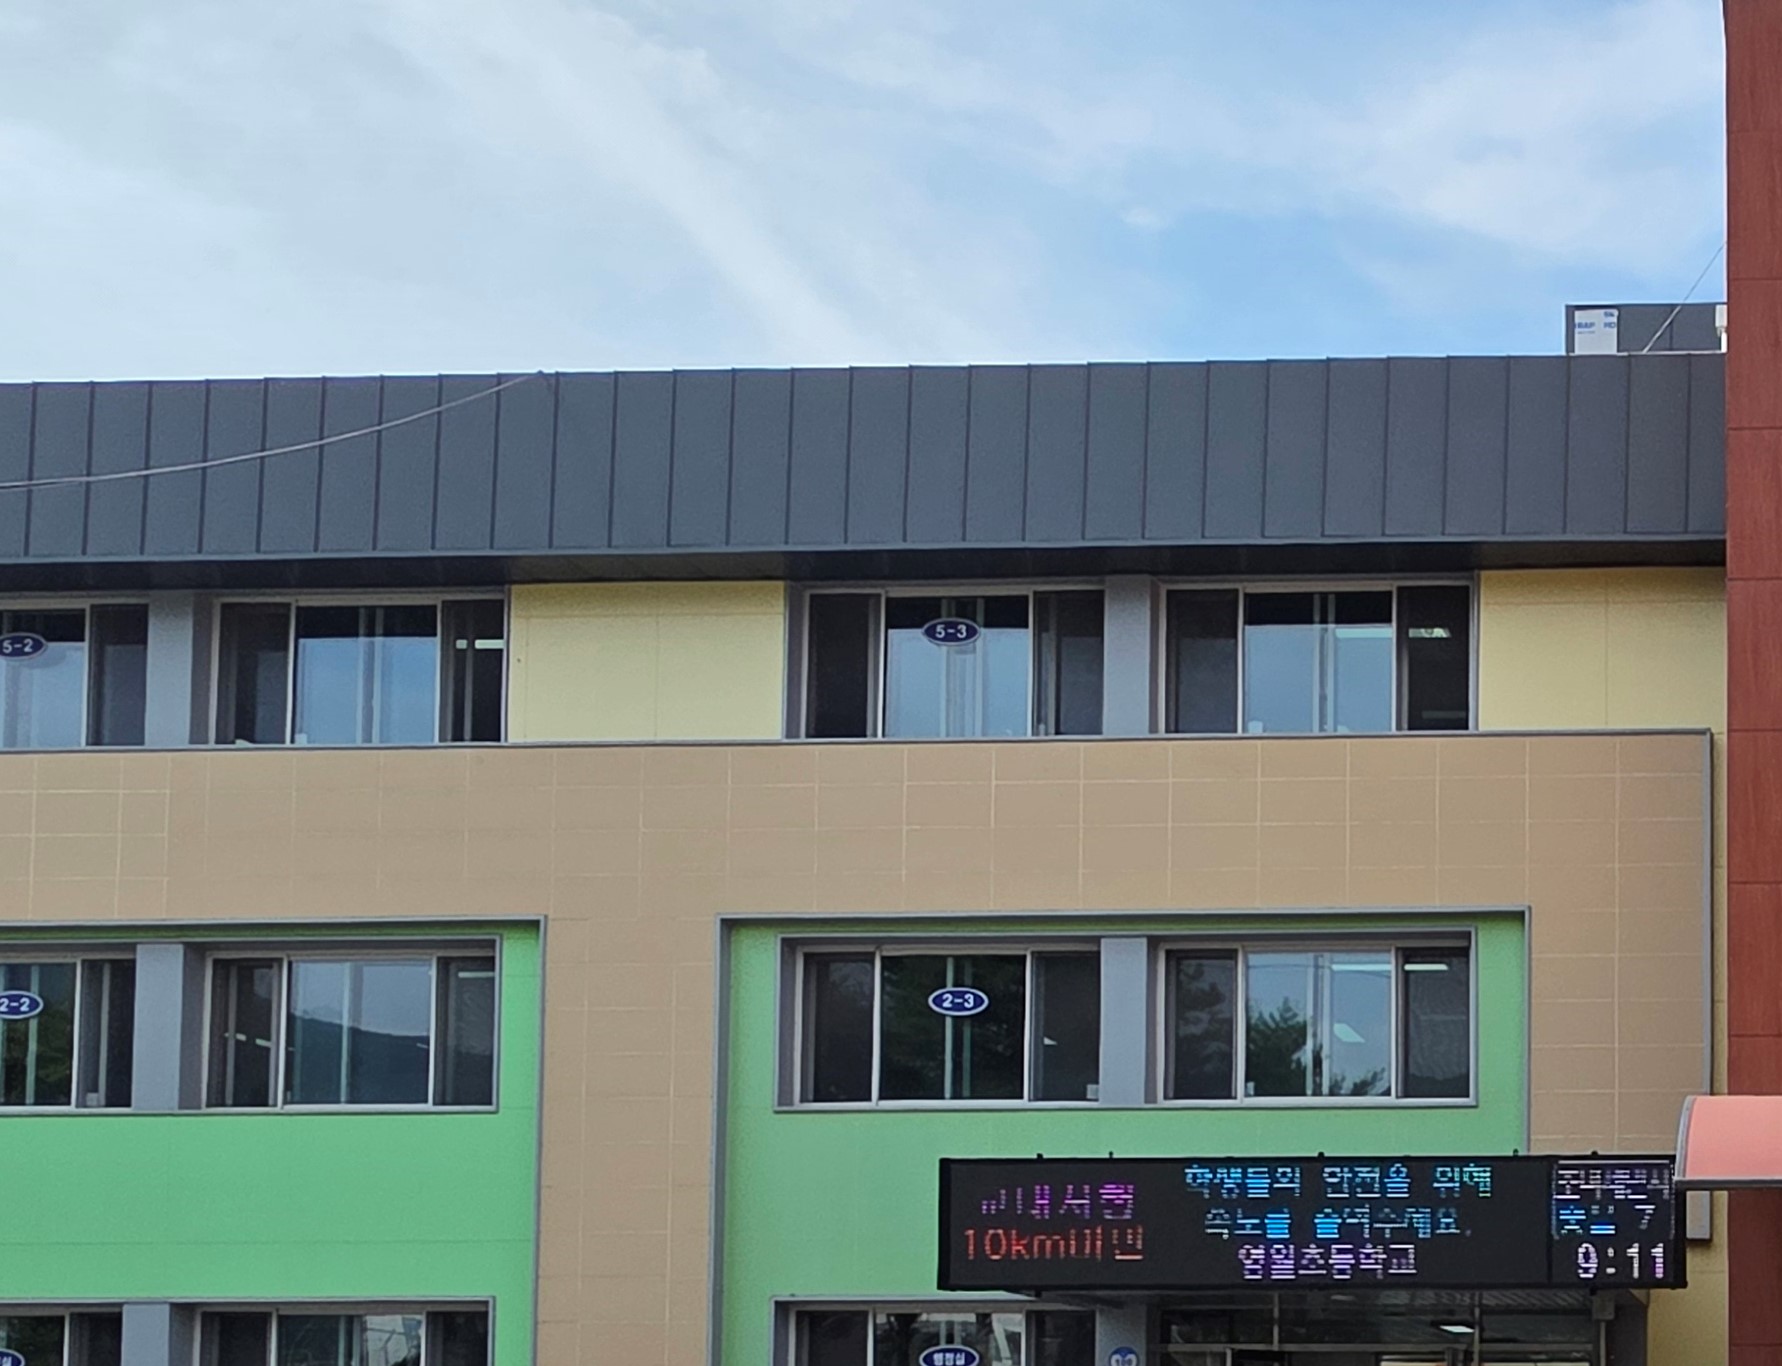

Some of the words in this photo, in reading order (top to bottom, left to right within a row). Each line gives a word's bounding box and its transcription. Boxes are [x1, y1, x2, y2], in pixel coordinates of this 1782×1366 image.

[933, 623, 968, 640] 5-3
[2, 638, 34, 654] 5-2
[0, 997, 30, 1012] 2-2
[941, 992, 975, 1009] 2-3
[1578, 1242, 1665, 1279] 9:11
